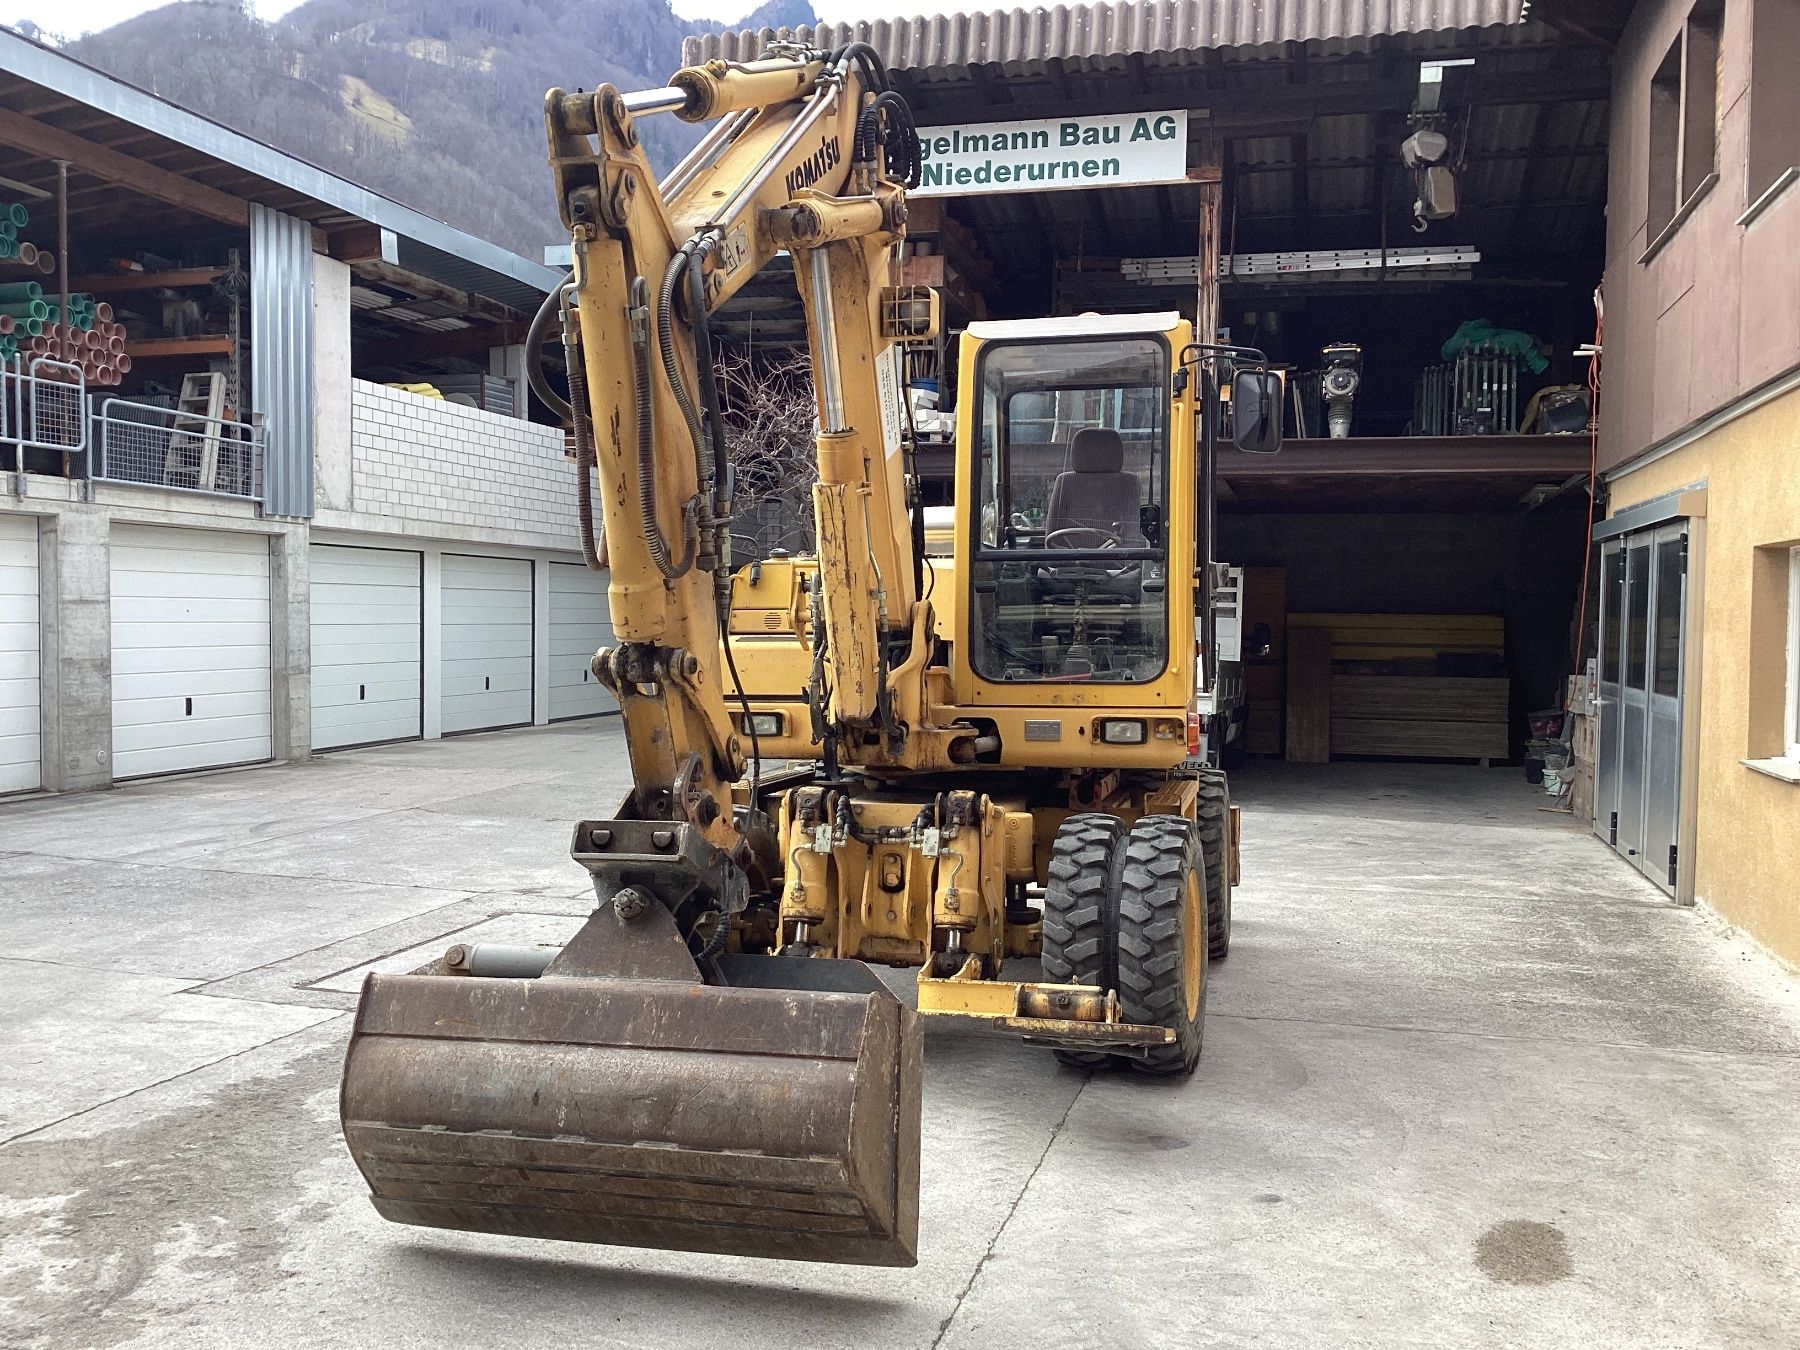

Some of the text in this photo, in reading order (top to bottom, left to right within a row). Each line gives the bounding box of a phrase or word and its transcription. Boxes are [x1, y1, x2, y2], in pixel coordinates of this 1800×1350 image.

[1060, 122, 1120, 147] Bau
[1129, 115, 1176, 142] AG
[785, 135, 841, 201] KOMATSU
[922, 157, 1120, 187] Niederurnen
[1174, 761, 1212, 770] VECO
